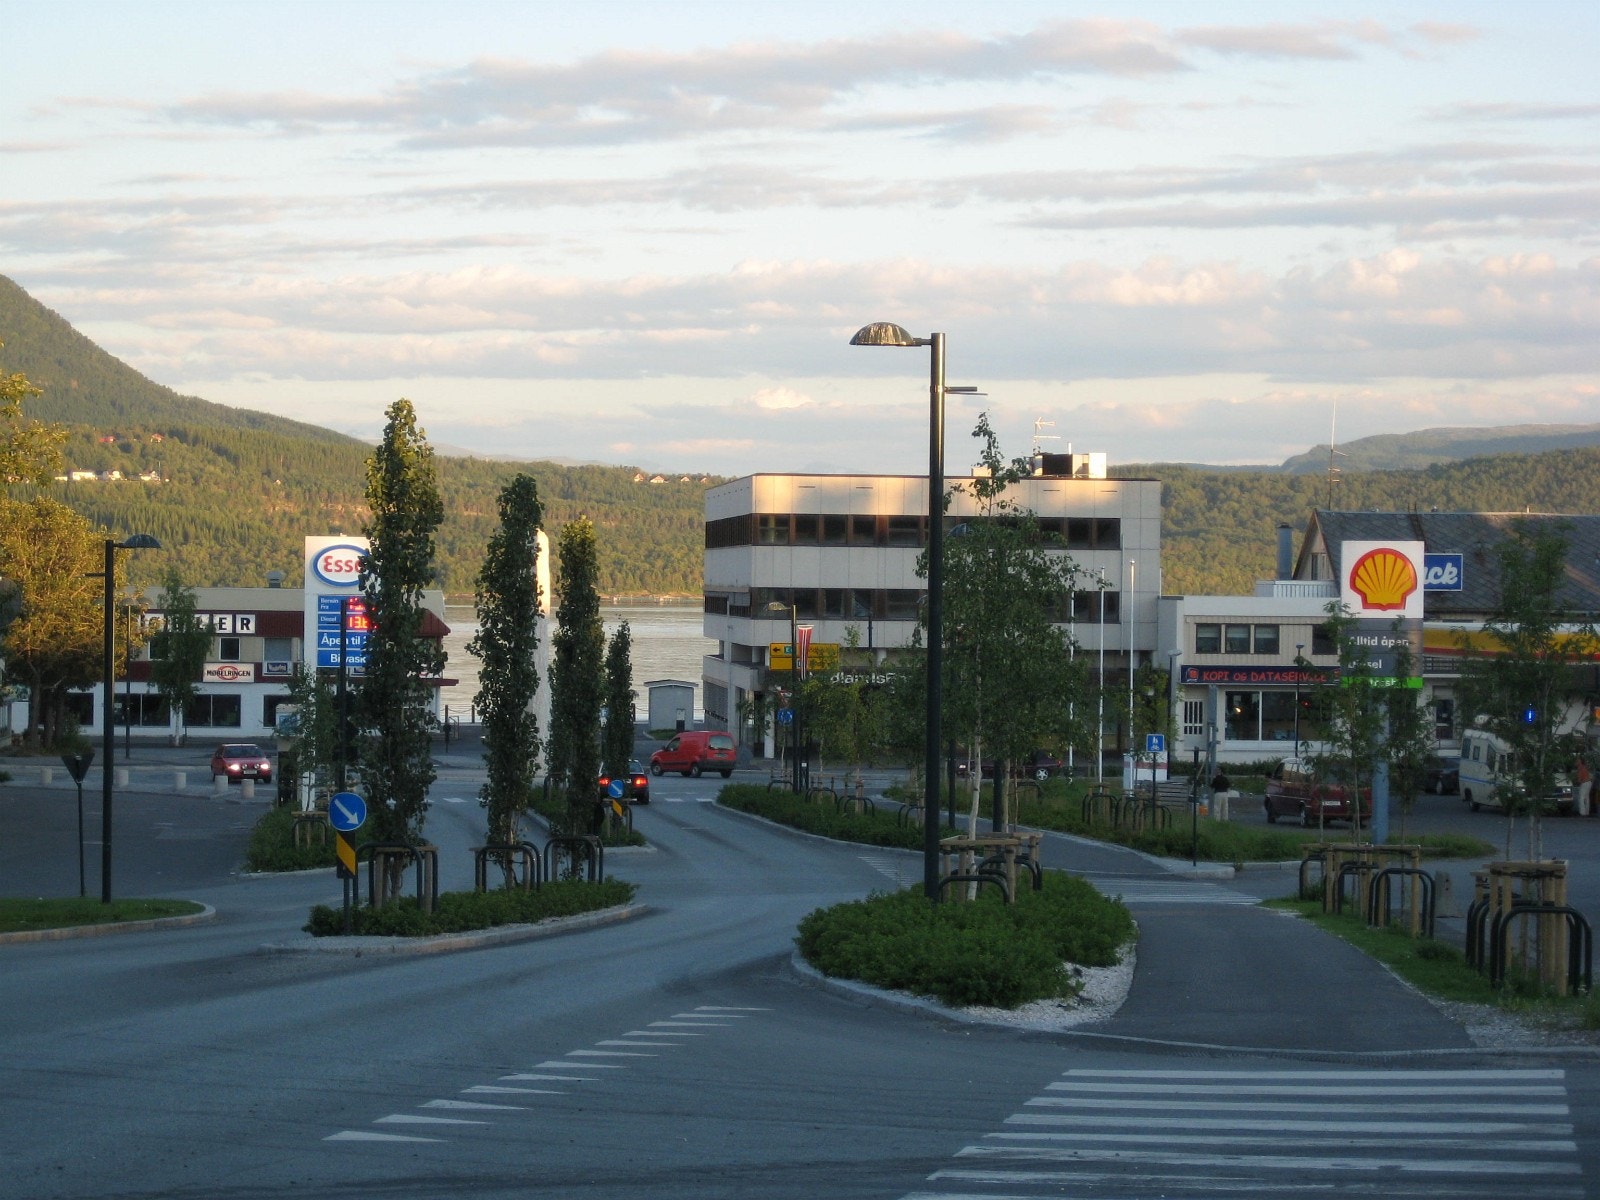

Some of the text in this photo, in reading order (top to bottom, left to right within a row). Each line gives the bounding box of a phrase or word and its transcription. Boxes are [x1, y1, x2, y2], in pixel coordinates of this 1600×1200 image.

[351, 636, 361, 645] til
[330, 653, 367, 664] Bivask
[206, 669, 251, 677] MØBELRINGEN
[1203, 671, 1229, 681] KOPI
